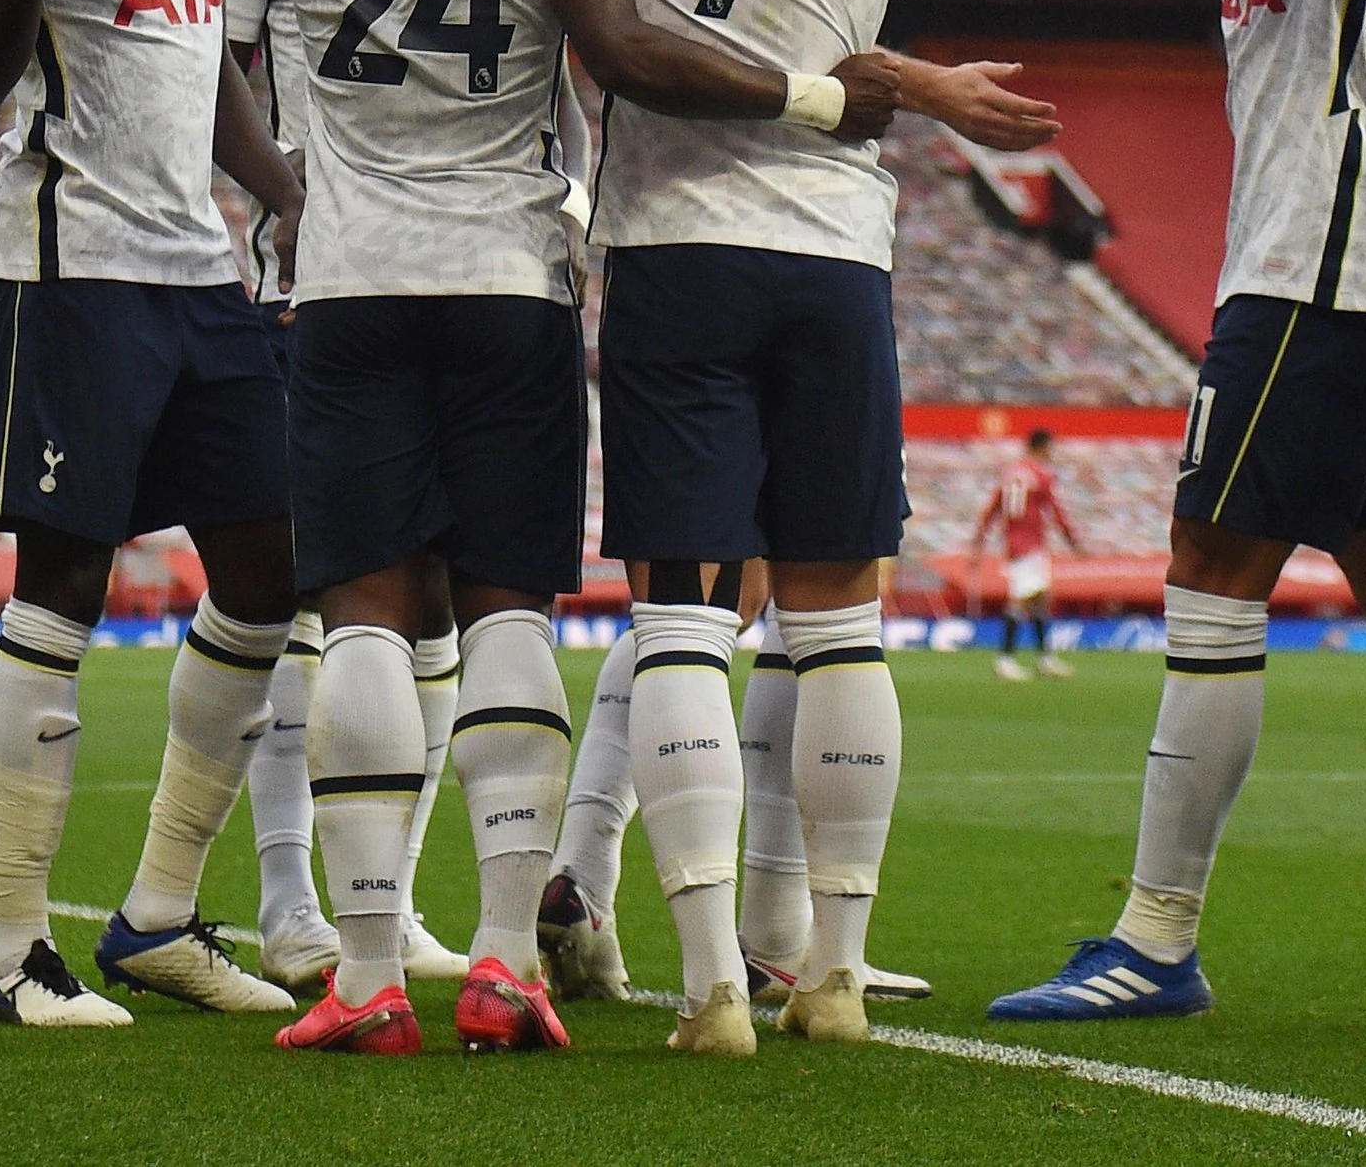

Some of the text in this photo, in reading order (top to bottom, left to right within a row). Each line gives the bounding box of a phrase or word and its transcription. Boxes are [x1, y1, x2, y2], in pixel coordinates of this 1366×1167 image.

[658, 738, 720, 757] SPURS
[821, 752, 886, 766] SPURS
[485, 808, 536, 828] SPURS
[352, 879, 397, 891] SPURS
